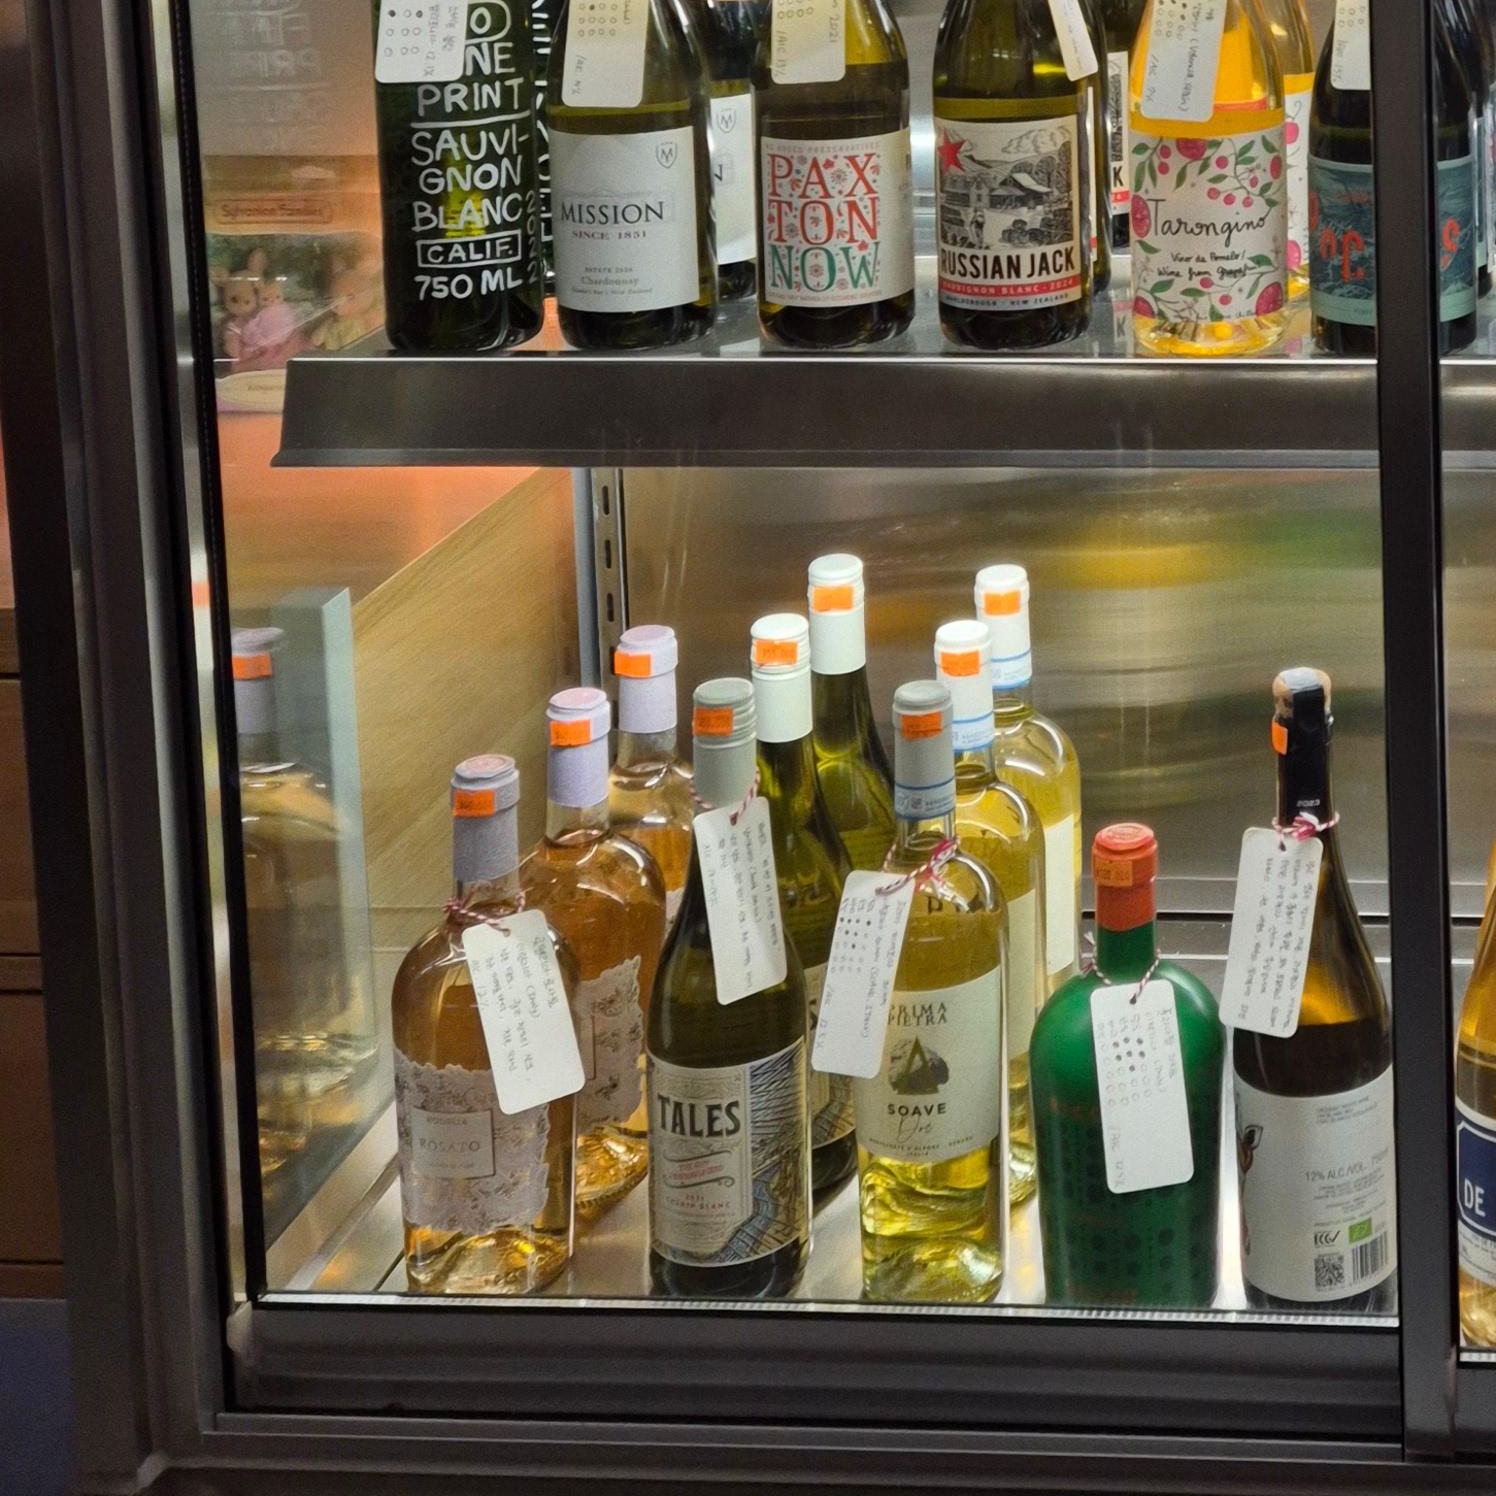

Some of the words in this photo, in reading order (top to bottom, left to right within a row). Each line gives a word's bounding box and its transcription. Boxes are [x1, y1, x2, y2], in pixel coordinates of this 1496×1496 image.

[465, 41, 514, 77] NE
[417, 77, 525, 117] PRINT
[411, 123, 530, 167] SAUVI-
[418, 154, 523, 196] GNON
[766, 152, 879, 201] PAX
[412, 192, 523, 233] BLANC
[560, 200, 665, 226] MISSION
[767, 196, 880, 246] TON
[1147, 197, 1267, 248] Tarongino
[427, 240, 514, 265] CALIF.
[571, 229, 611, 241] SINCE
[617, 230, 648, 241] 1851
[769, 241, 881, 293] NOW
[940, 248, 1022, 280] RUSSIAN
[1026, 245, 1076, 278] JACK
[414, 273, 474, 301] 750
[480, 268, 524, 296] ML
[1001, 283, 1040, 296] BLANC
[657, 1093, 741, 1138] TALES
[887, 1102, 947, 1117] SOAVE
[1463, 1177, 1487, 1218] DE
